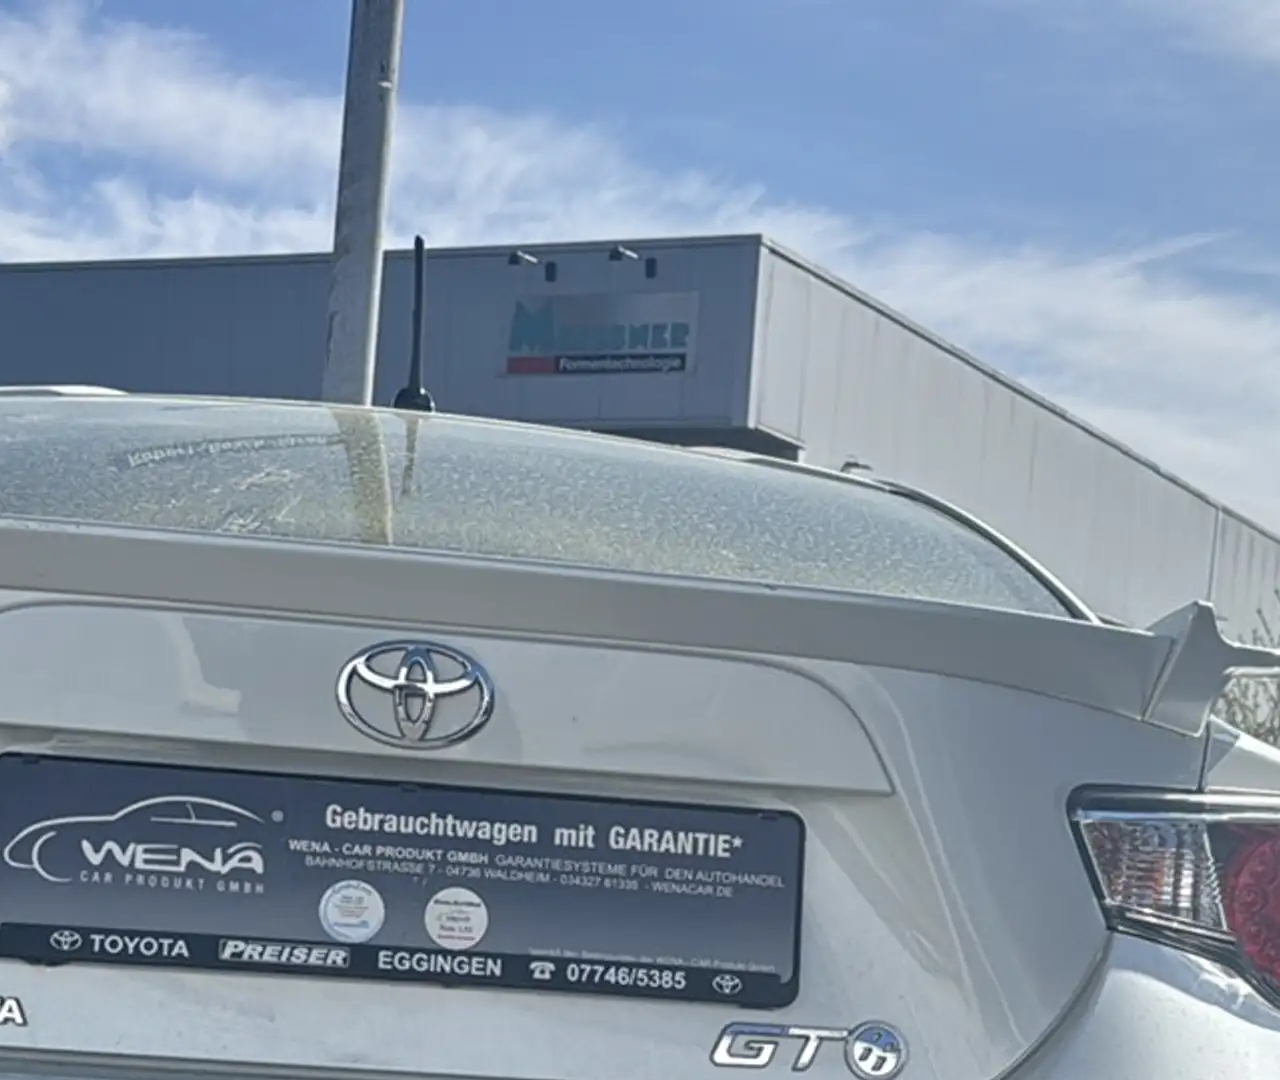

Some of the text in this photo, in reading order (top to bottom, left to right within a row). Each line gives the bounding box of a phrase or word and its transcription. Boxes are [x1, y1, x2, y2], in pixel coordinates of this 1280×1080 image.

[325, 804, 538, 845] Gebrauchtwagen
[554, 824, 596, 848] mit
[81, 839, 264, 875] WENA
[288, 839, 331, 854] WENA
[342, 843, 372, 856] CAR
[376, 845, 444, 861] PRODUKT
[446, 850, 489, 864] GMBH
[80, 870, 265, 894] CAR PRODUKT GMBH
[90, 934, 190, 958] TOYOTA
[221, 939, 349, 967] PREISER
[377, 950, 503, 978] EGGINGEN
[566, 965, 687, 991] 07746/5385
